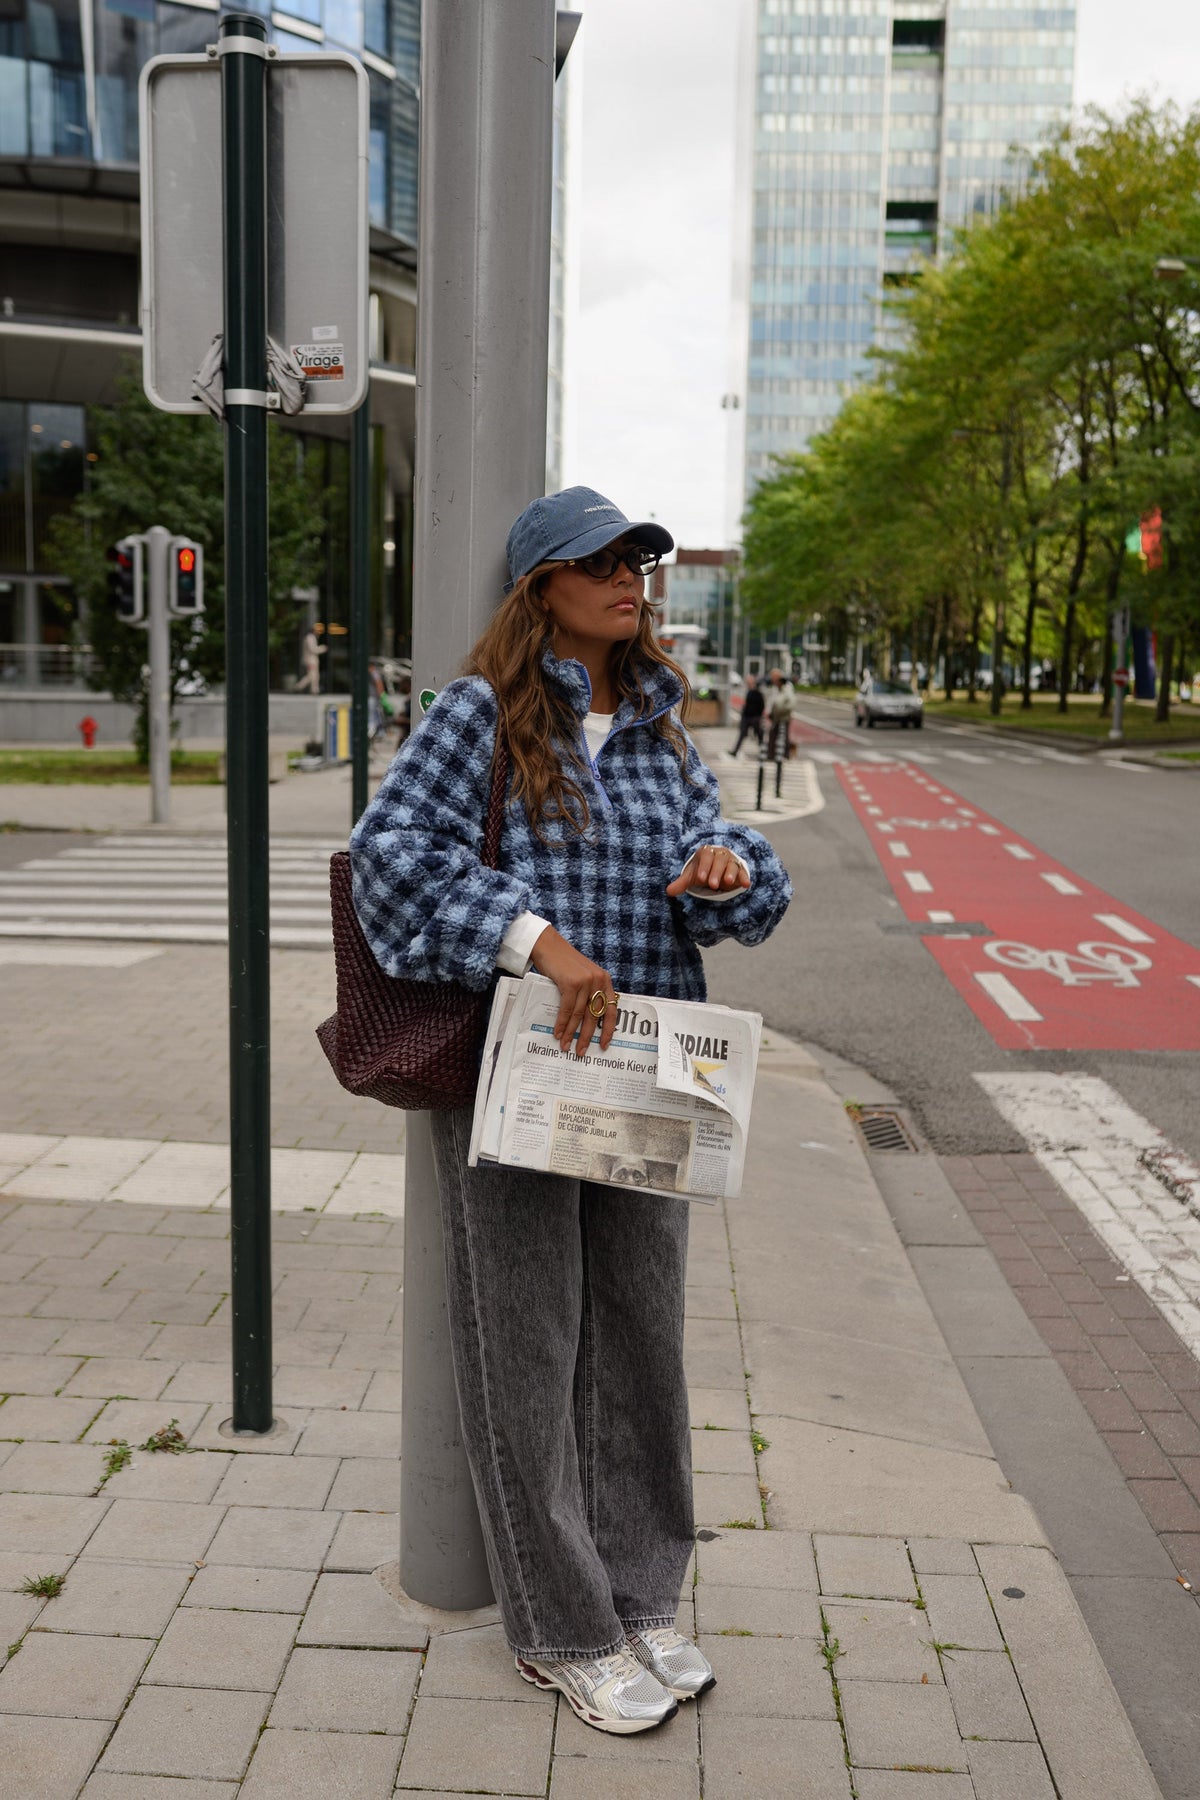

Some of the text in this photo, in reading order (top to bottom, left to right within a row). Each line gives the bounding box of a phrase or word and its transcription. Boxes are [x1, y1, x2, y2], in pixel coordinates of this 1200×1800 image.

[295, 355, 340, 369] Virage
[527, 1042, 558, 1058] Ukraine
[566, 1049, 592, 1064] Trump
[593, 1056, 625, 1070] renvoie
[626, 1060, 646, 1074] Kiev
[648, 1064, 657, 1075] et
[559, 1114, 595, 1126] IMPLACABLE
[560, 1104, 616, 1120] LA CONDAMNATION
[557, 1122, 566, 1130] DE
[589, 1127, 617, 1139] JUBILLAR
